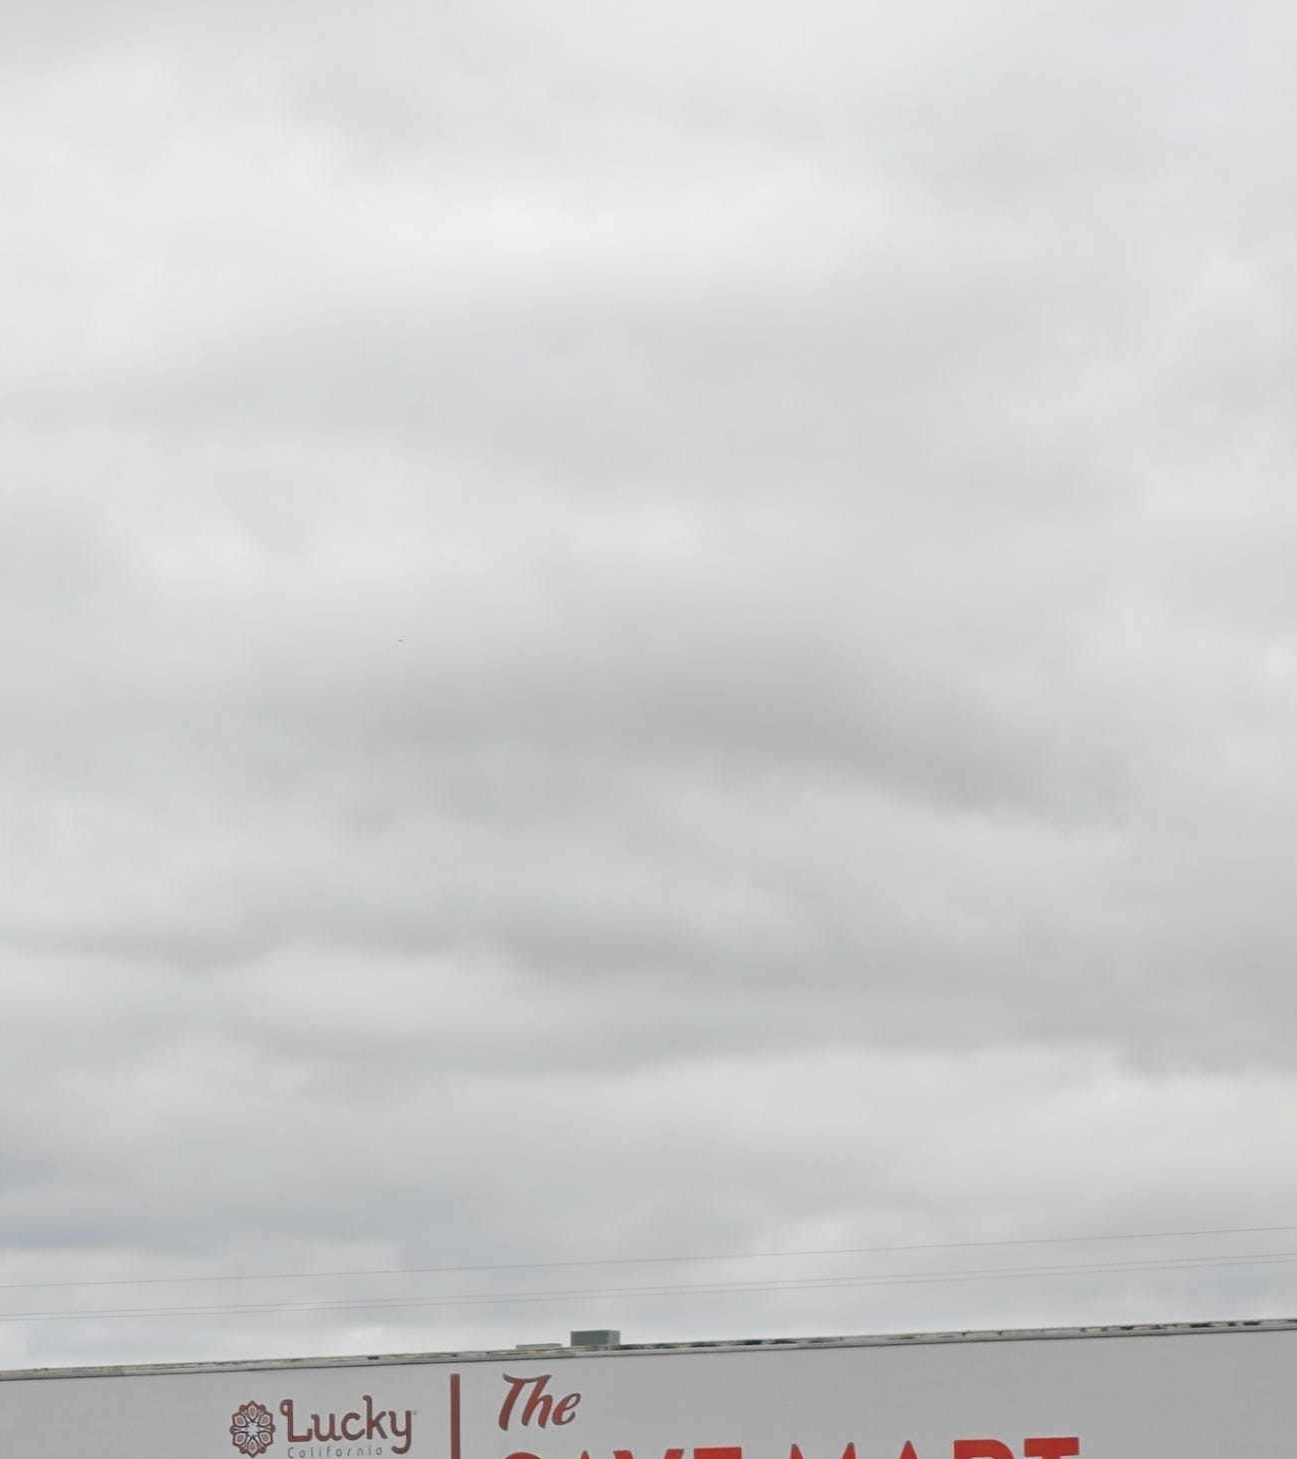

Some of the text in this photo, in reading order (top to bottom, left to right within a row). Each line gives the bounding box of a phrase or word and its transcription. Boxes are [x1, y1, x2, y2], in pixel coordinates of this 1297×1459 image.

[280, 1395, 413, 1455] Lucky
[498, 1373, 582, 1432] The
[287, 1445, 383, 1459] California
